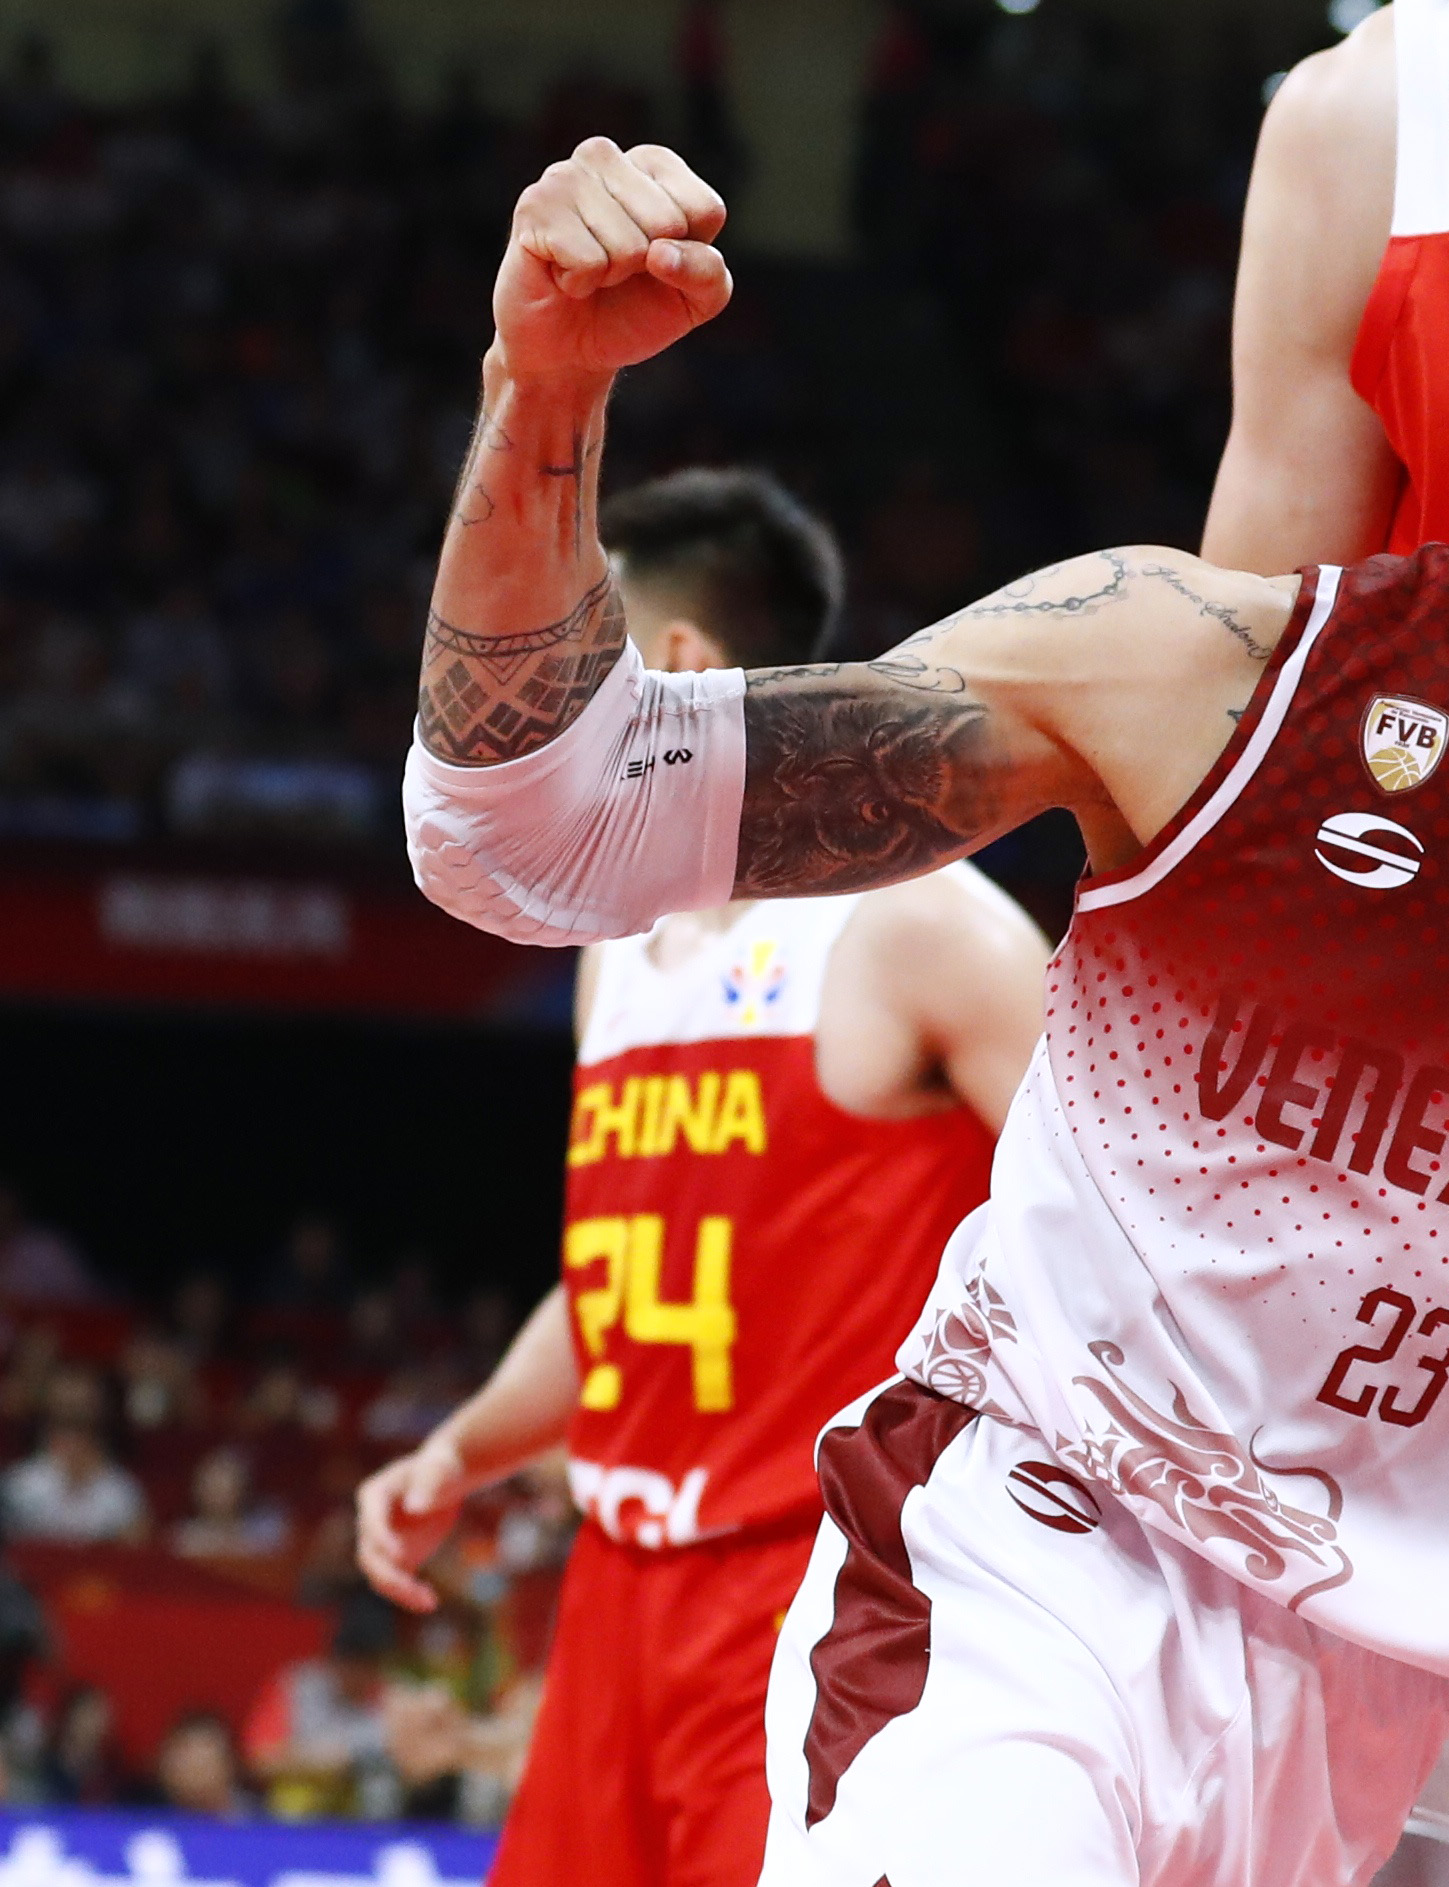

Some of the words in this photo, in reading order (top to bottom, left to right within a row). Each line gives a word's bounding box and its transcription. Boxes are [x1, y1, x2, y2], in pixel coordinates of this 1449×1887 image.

[1376, 713, 1438, 748] FVB
[567, 1070, 766, 1168] CHINA
[564, 1213, 736, 1413] 24
